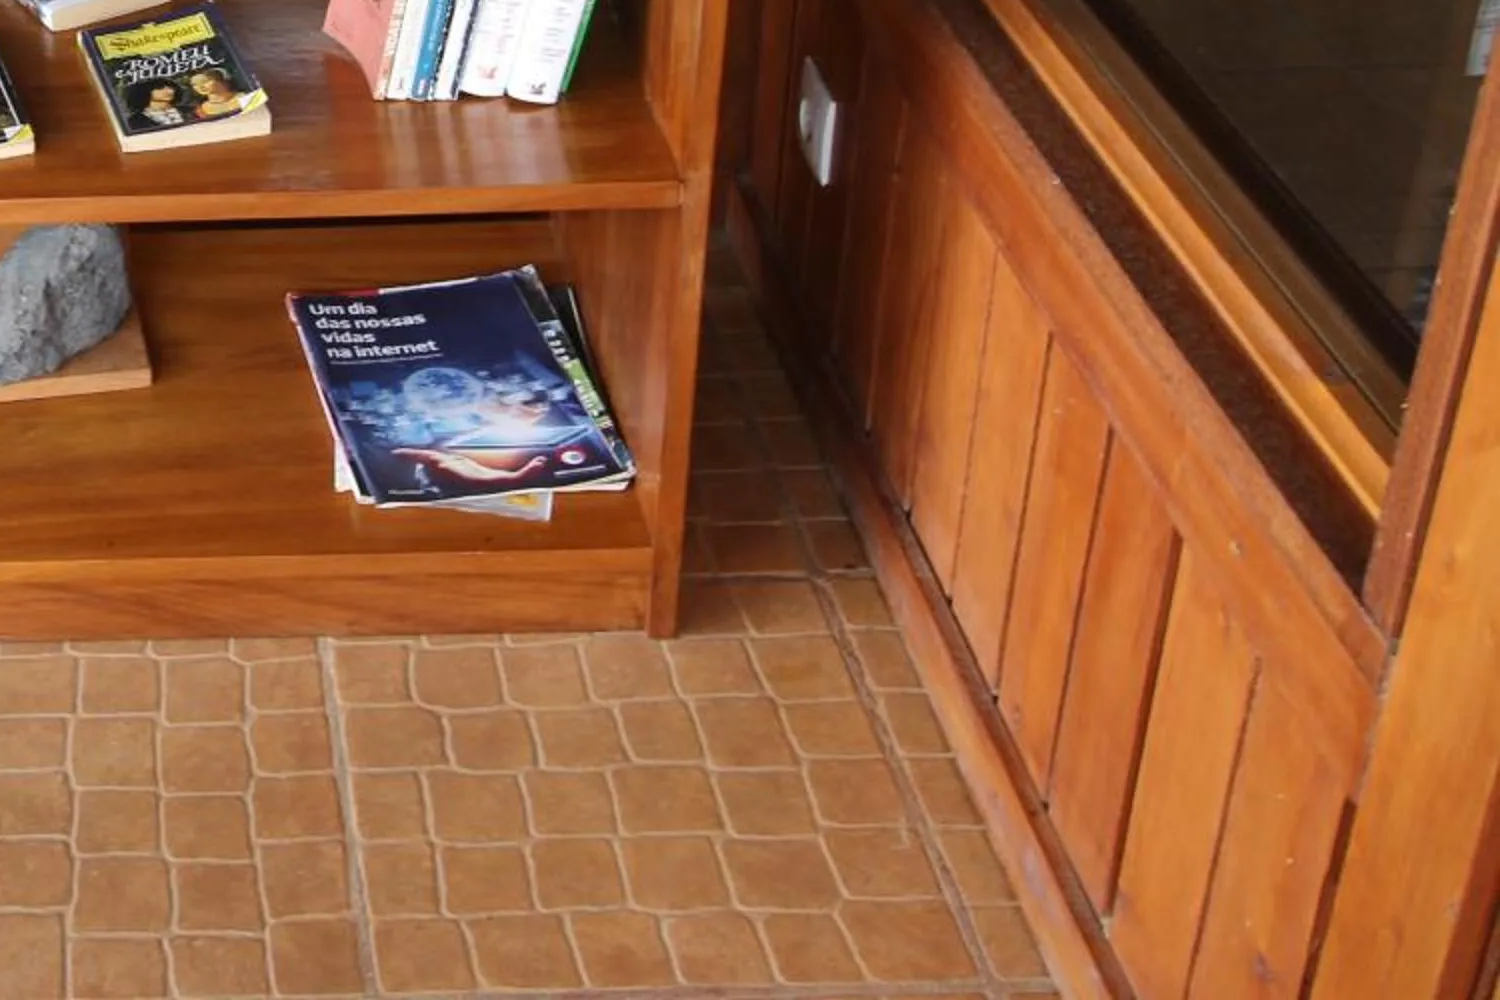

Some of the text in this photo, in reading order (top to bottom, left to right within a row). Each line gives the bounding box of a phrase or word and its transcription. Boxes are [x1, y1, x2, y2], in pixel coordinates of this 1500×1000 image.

[307, 302, 378, 316] Um dia
[315, 313, 427, 330] das nossas
[320, 331, 377, 343] vidas
[326, 338, 441, 359] na internet
